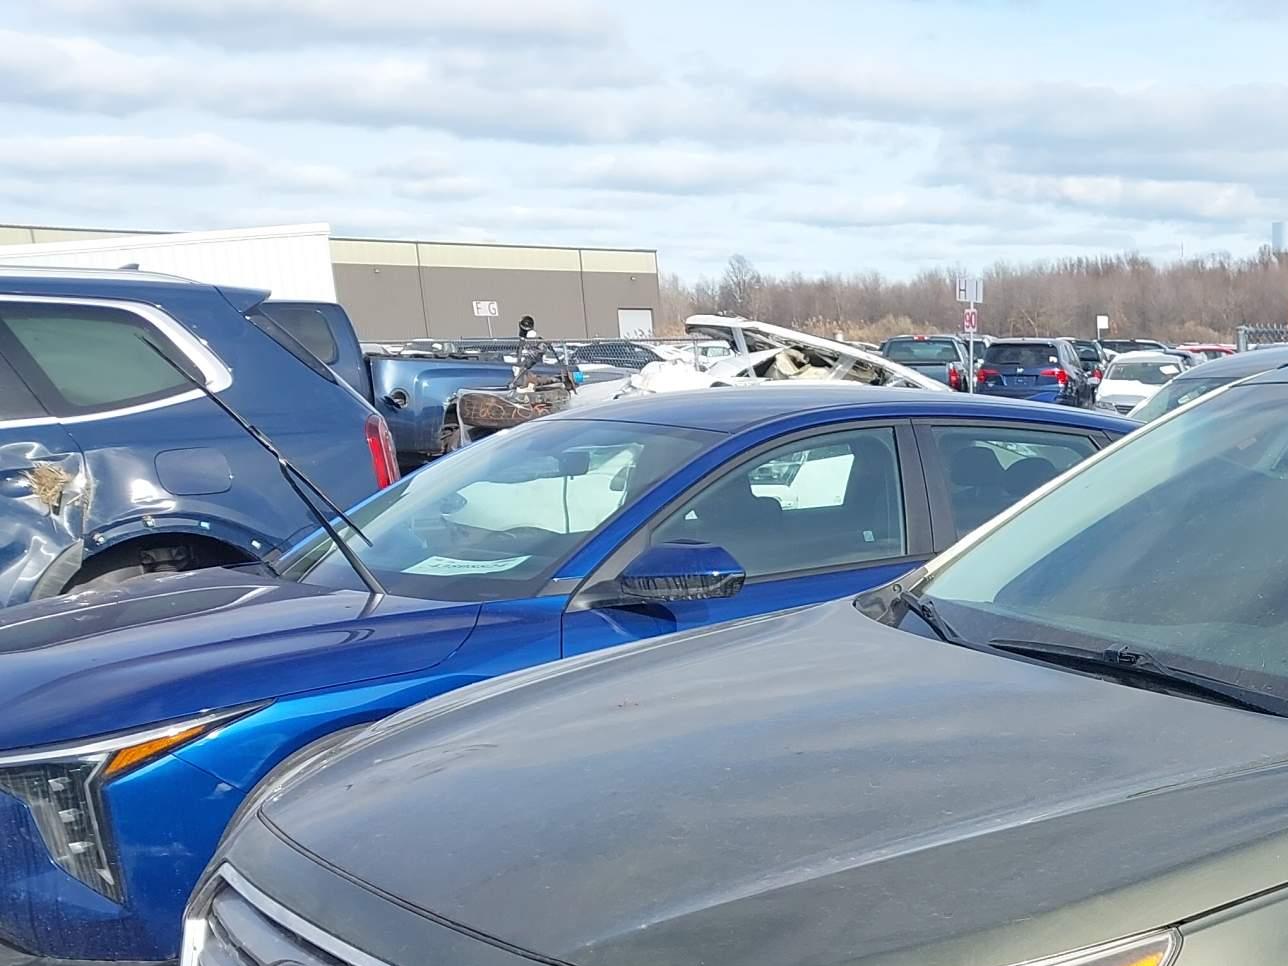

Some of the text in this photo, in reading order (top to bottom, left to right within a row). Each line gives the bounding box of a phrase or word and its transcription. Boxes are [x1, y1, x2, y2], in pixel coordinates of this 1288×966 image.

[958, 279, 967, 300] H
[475, 302, 497, 316] F G
[964, 311, 977, 329] 90
